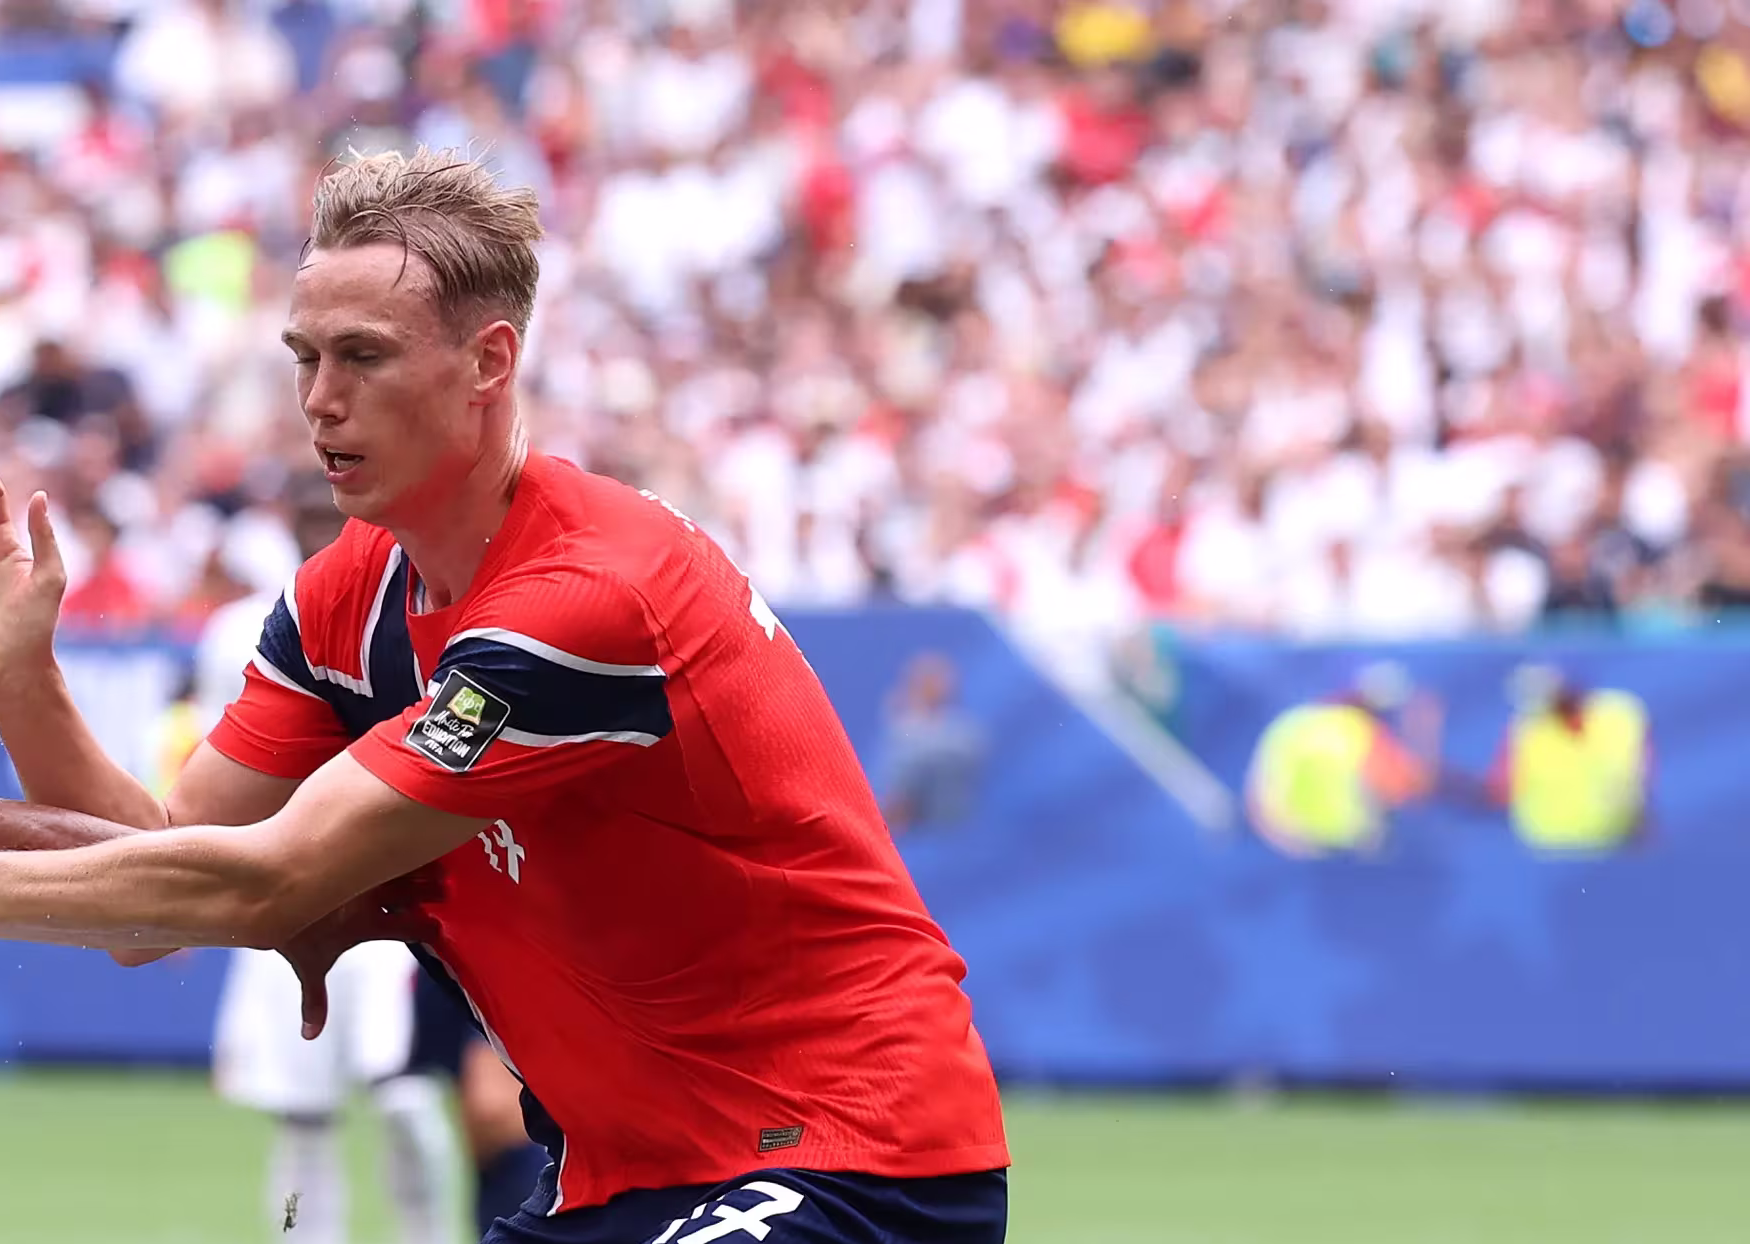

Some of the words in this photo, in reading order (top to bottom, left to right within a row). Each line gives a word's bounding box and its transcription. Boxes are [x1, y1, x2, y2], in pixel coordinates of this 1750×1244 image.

[433, 709, 460, 732] Unite
[421, 719, 472, 758] EDUCATION
[424, 739, 444, 756] FIFA
